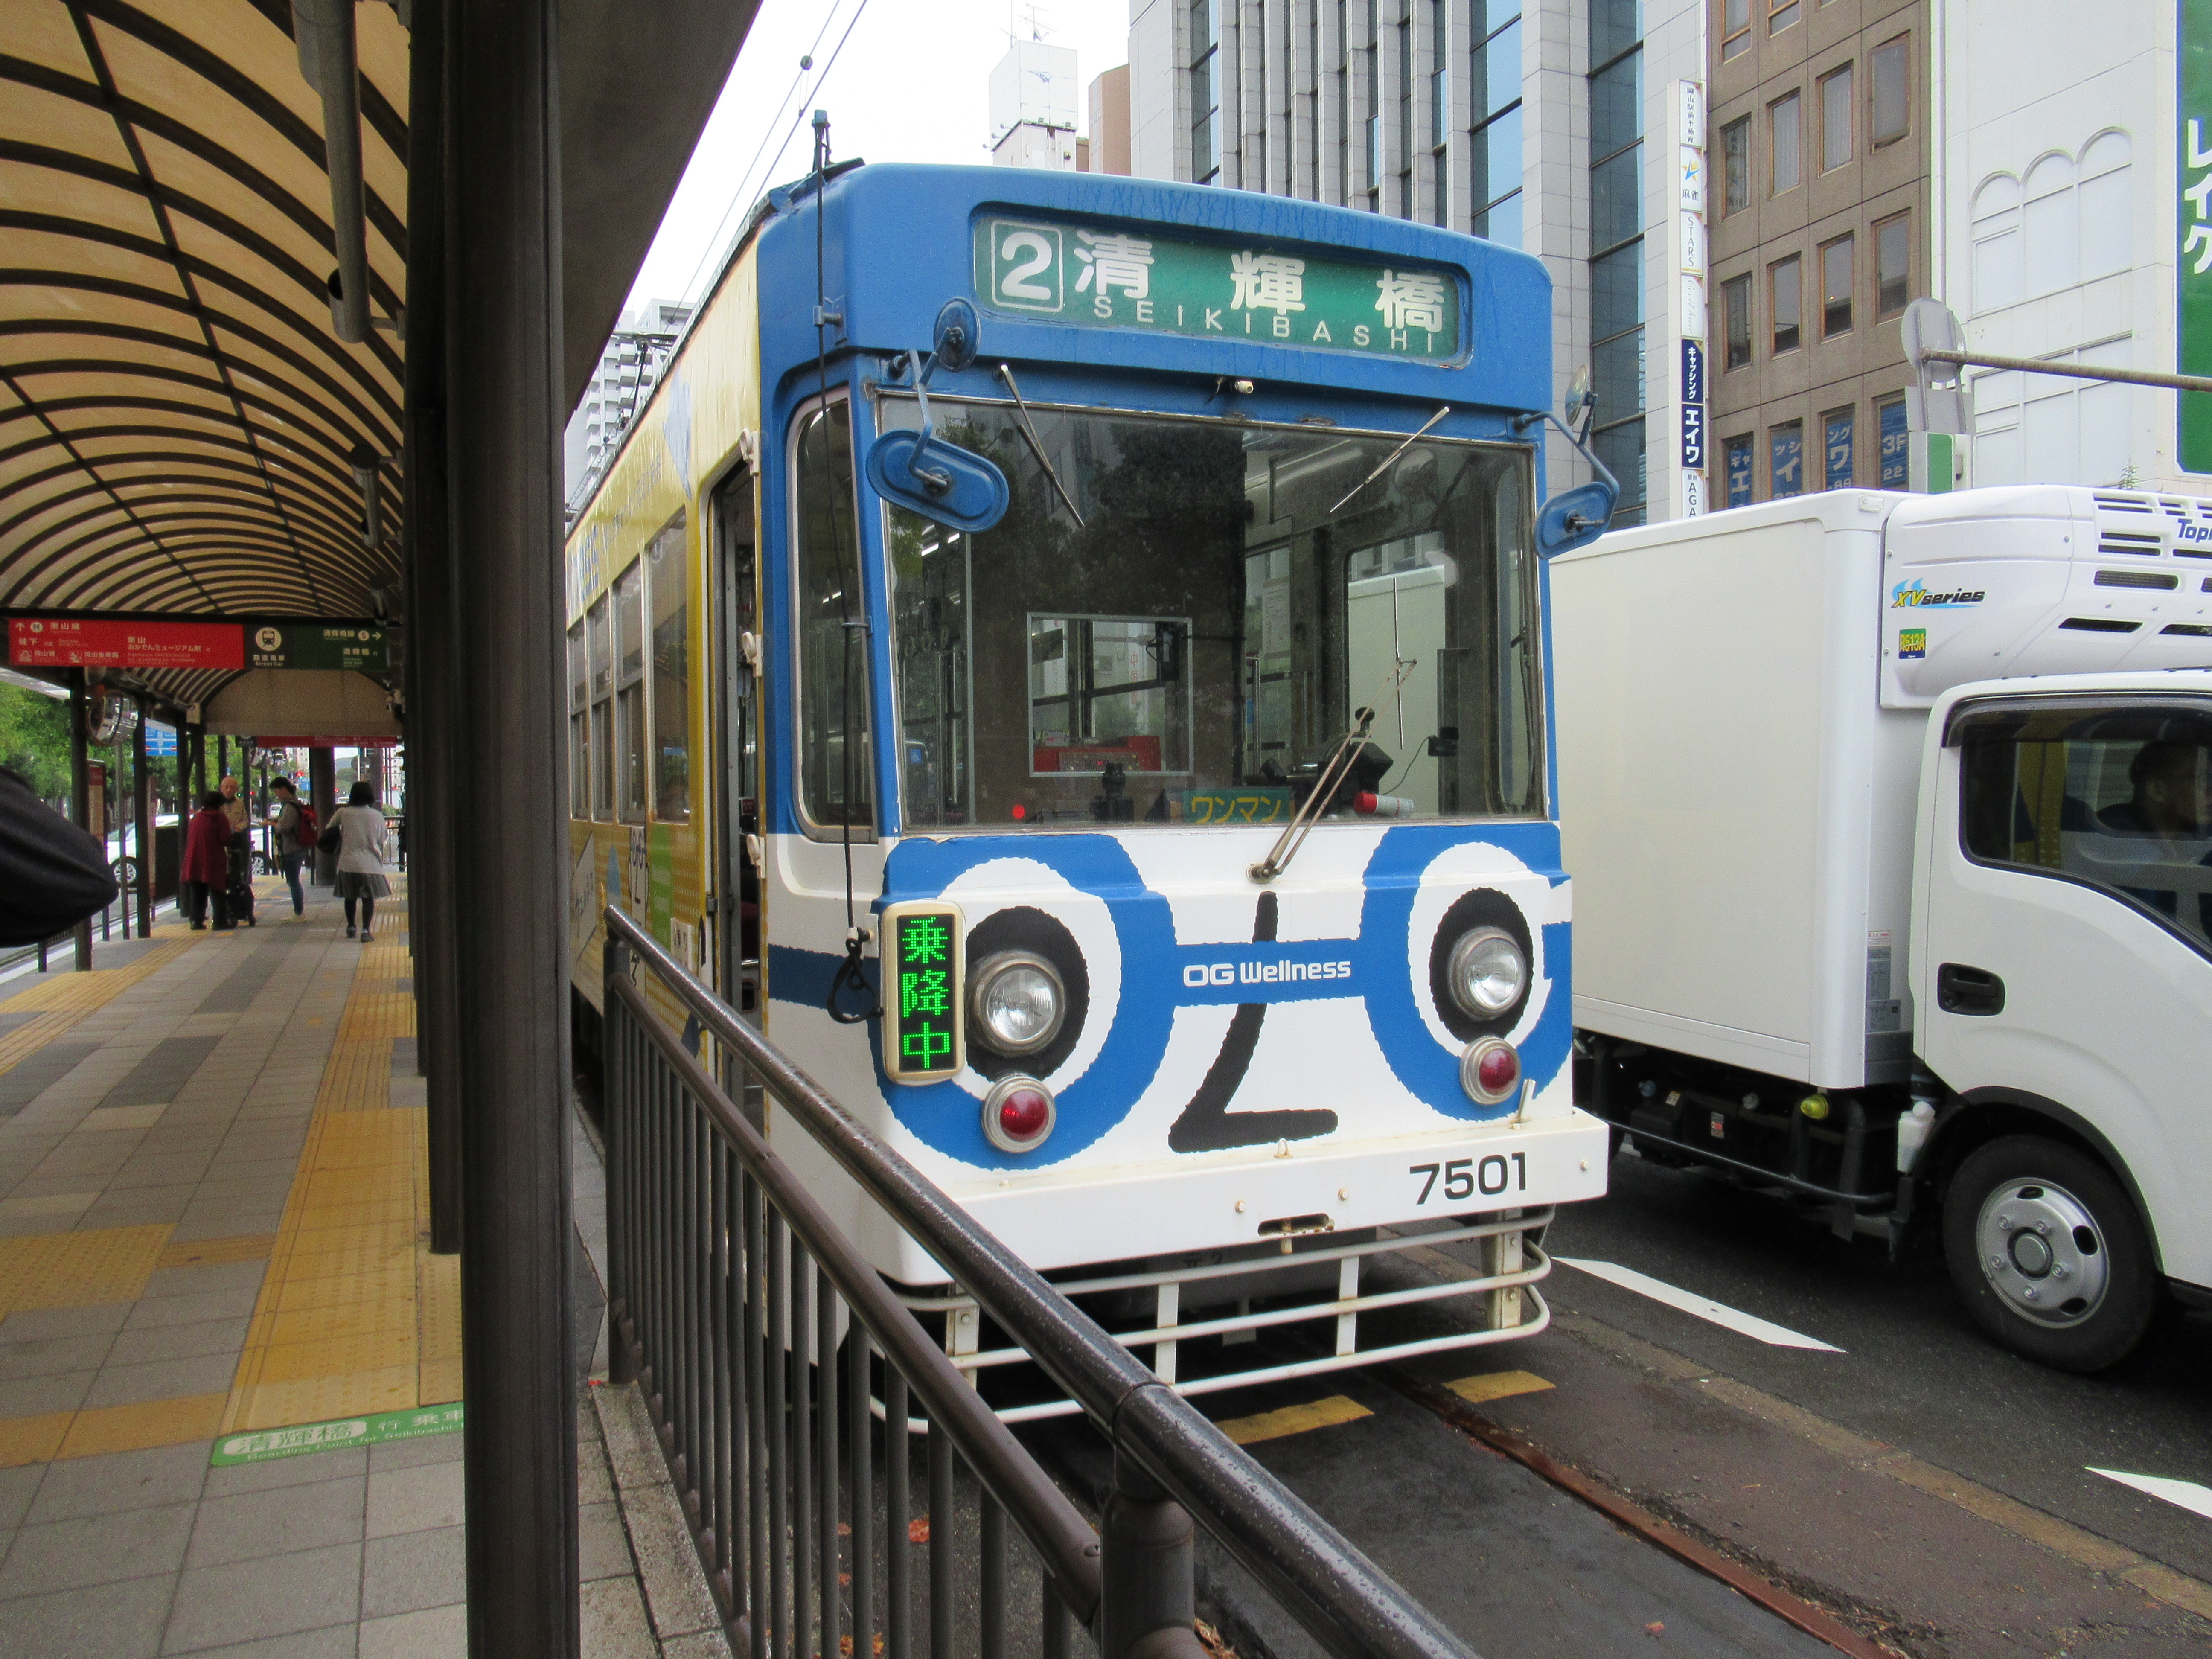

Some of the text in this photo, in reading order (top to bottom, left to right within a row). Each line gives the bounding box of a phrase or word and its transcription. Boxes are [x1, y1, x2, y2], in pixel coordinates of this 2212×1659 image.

[1682, 189, 1699, 201] 麻雀
[2184, 118, 2212, 274] レイク
[1001, 232, 1052, 300] 2
[1074, 230, 1445, 333] 清輝橋
[1094, 297, 1432, 354] SEIKIBASHI
[1688, 346, 1697, 400] キャッシング
[1685, 409, 1700, 463] エイワ
[1883, 433, 1907, 455] 3F
[1688, 482, 1697, 518] AGA
[2177, 518, 2212, 543] Top
[1191, 796, 1281, 824] ワンマン
[902, 917, 950, 1068] 乗降中
[1183, 960, 1351, 987] OG Wellness
[1409, 1151, 1526, 1205] 7501
